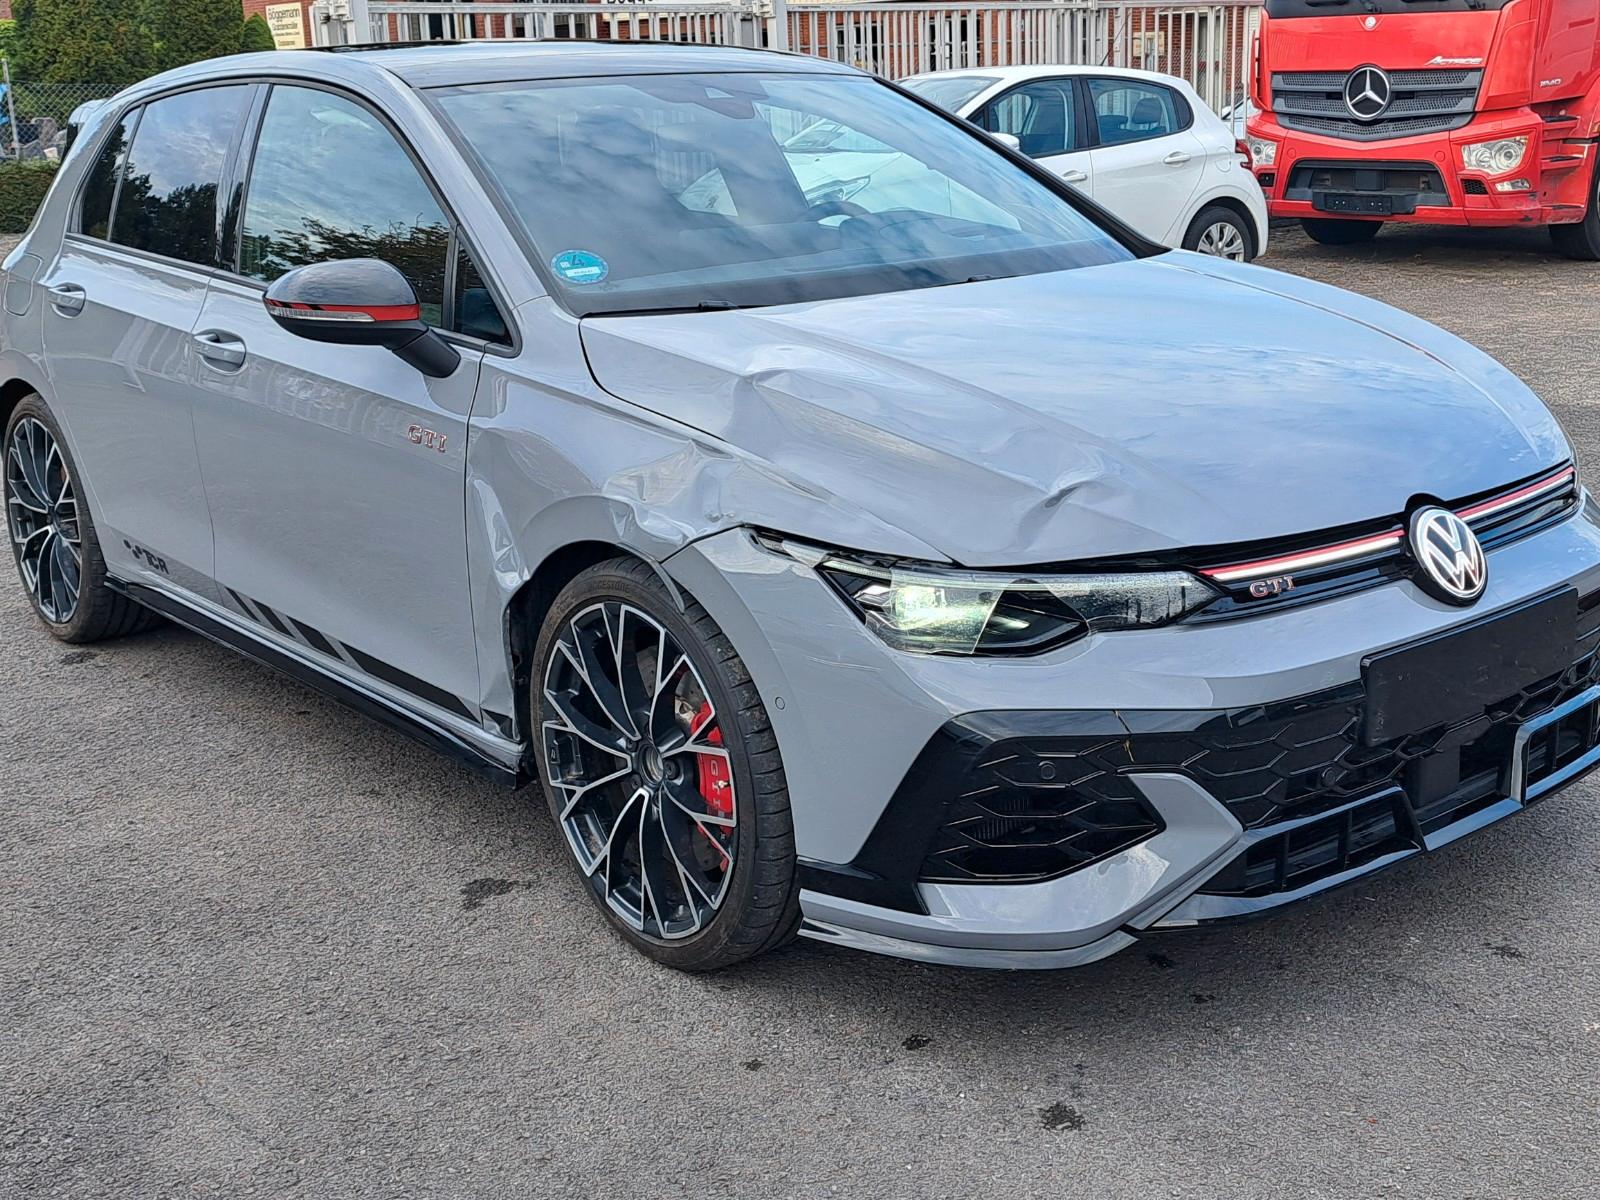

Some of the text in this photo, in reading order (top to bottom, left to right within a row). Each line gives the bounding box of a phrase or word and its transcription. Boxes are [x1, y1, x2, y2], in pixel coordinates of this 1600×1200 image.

[571, 254, 585, 266] 4
[408, 424, 447, 453] GTI
[1249, 575, 1295, 598] GTI
